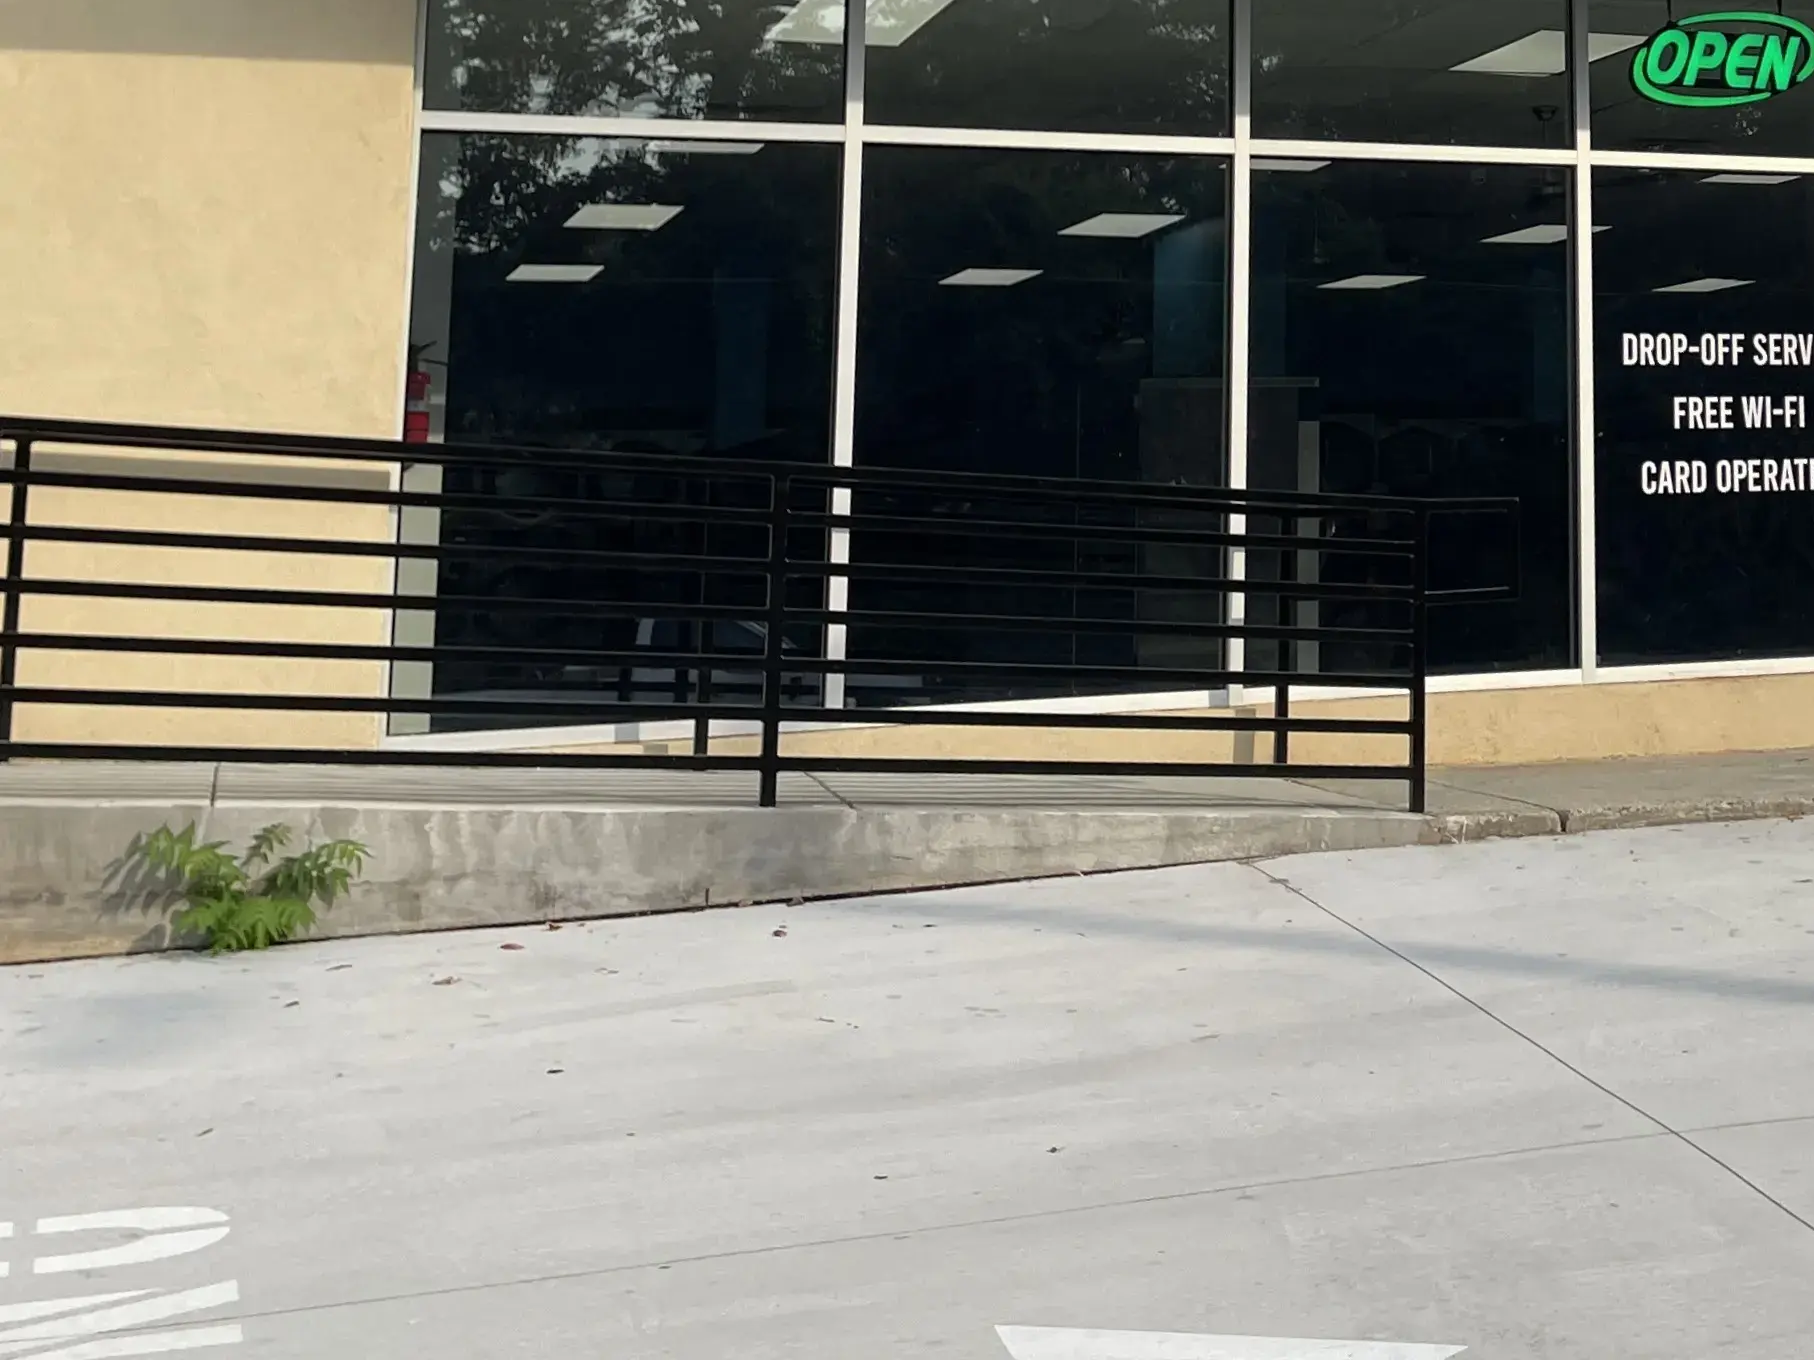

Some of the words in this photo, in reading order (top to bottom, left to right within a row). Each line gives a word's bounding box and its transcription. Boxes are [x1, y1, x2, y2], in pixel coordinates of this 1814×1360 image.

[1645, 27, 1803, 92] OPEN
[1622, 332, 1745, 366] DROP-OFF
[1673, 395, 1734, 429] FREE
[1741, 395, 1806, 428] WI-FI
[1641, 460, 1708, 494] CARD
